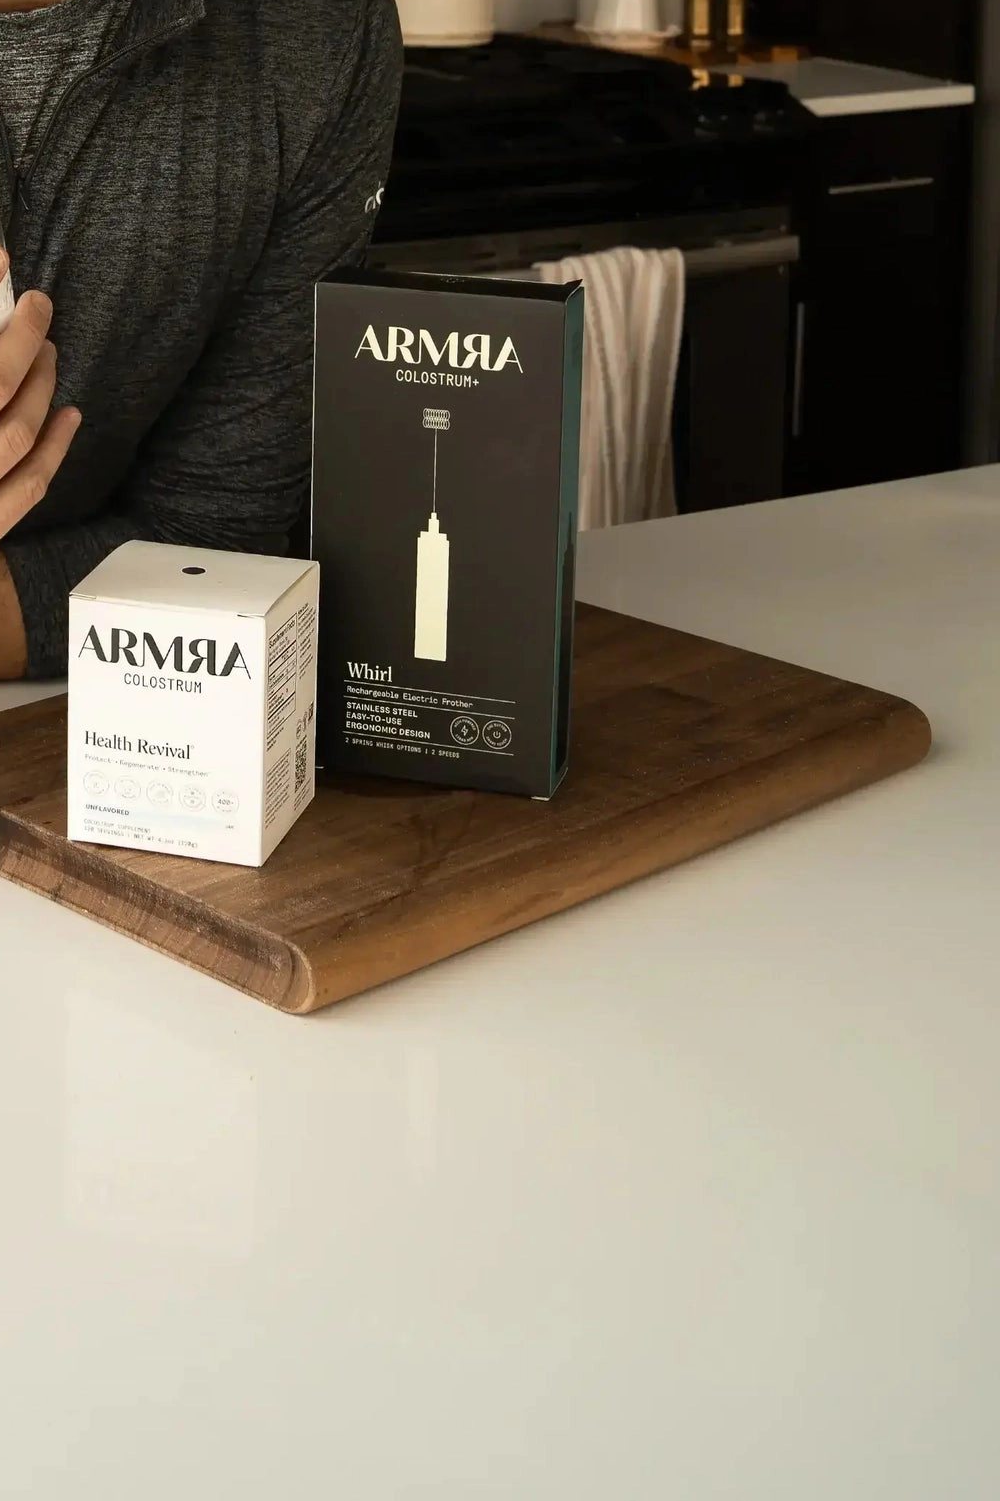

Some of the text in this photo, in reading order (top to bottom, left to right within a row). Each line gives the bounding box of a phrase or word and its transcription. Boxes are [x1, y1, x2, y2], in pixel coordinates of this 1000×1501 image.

[395, 369, 479, 388] COLOSTRUM+
[347, 661, 392, 682] Whirl
[124, 672, 202, 694] COLOSTRUM
[346, 685, 474, 708] Rechargeable Electric Frother
[346, 701, 418, 718] STAINLESS STEEL
[346, 711, 402, 726] EASY-TO-USE
[345, 720, 431, 739] ERGONOMIC DESIGN
[85, 730, 190, 760] Health Revival
[352, 737, 373, 747] SPRING
[376, 741, 394, 749] WHISK
[396, 744, 422, 753] OPTIONS
[438, 750, 460, 759] SPEEDS
[85, 803, 130, 816] UNFLAVORED
